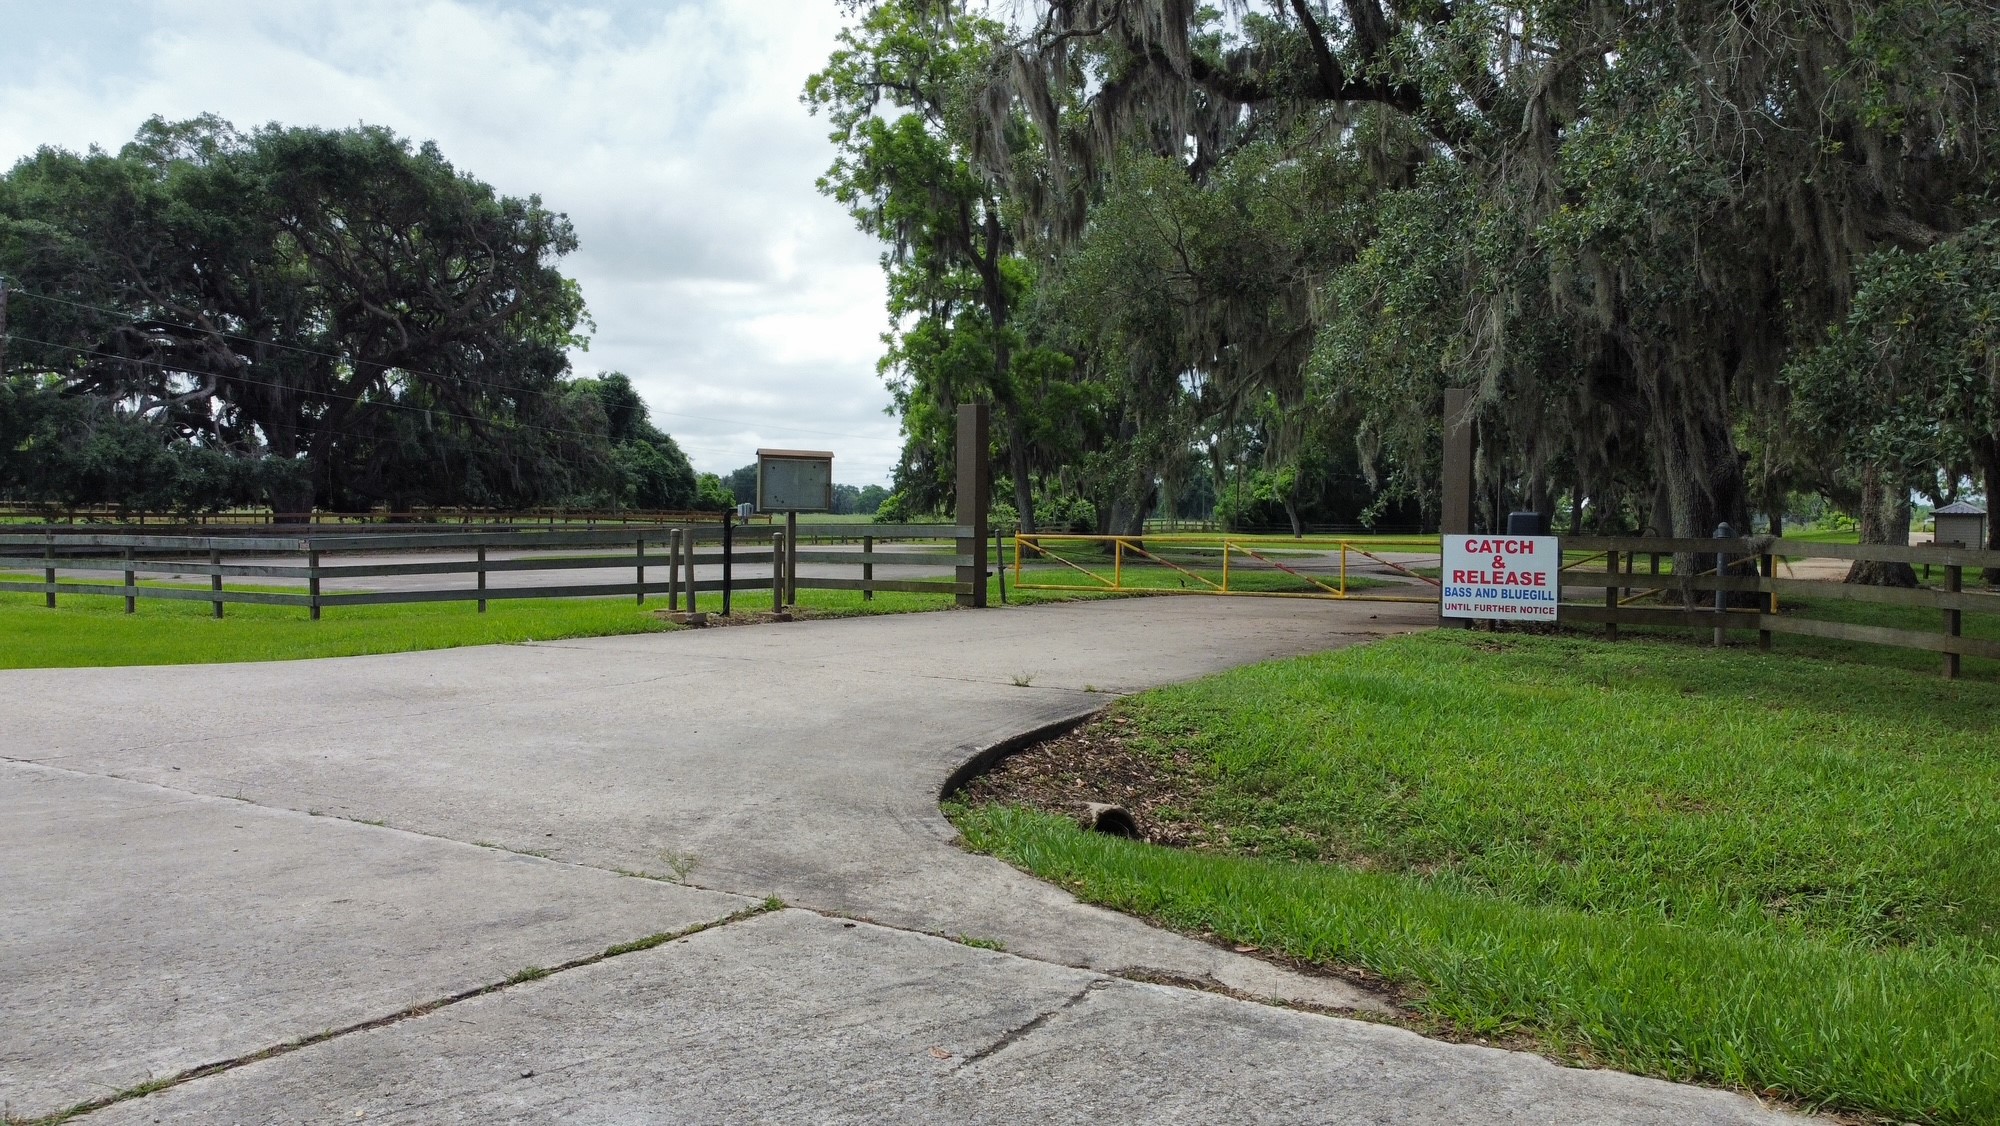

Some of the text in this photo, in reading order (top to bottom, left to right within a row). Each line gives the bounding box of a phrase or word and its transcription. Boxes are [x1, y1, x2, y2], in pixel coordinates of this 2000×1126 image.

[1465, 539, 1533, 554] CATCH
[1492, 555, 1506, 569] &
[1453, 570, 1546, 586] RELEASE
[1445, 587, 1555, 601] BASS AND BLUEGILL
[1445, 603, 1555, 615] UNTIL FURTHER NOTICE
